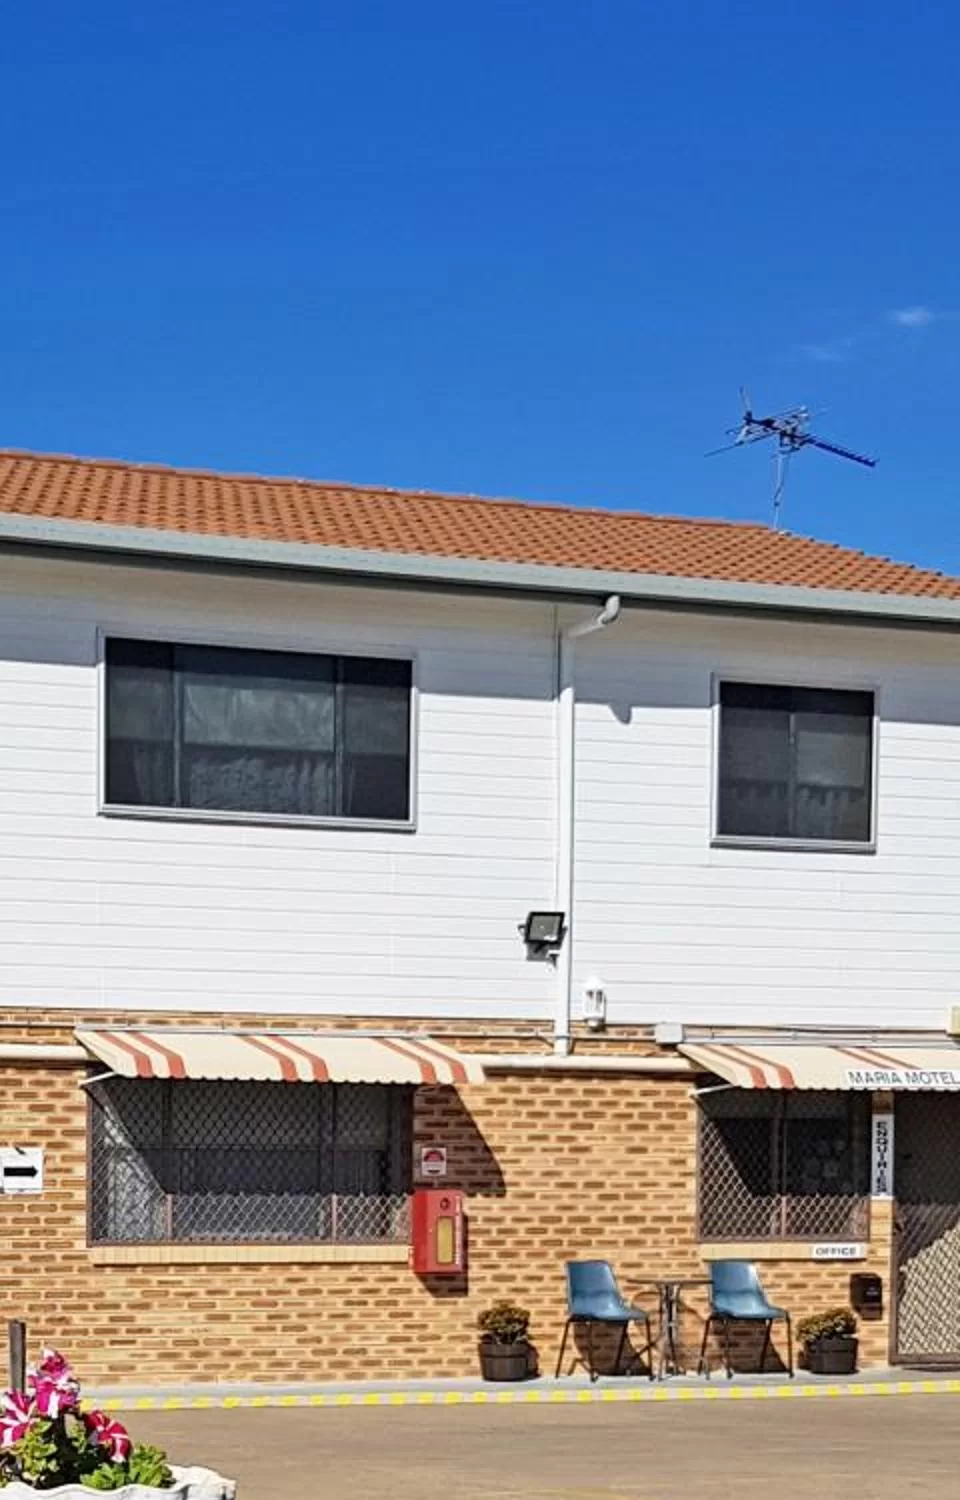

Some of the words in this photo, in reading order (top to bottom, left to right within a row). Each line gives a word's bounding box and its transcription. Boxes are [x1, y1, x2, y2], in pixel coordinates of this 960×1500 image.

[848, 1071, 902, 1085] MARIA
[905, 1071, 960, 1085] MOTEL
[815, 1246, 857, 1257] OFFICE
